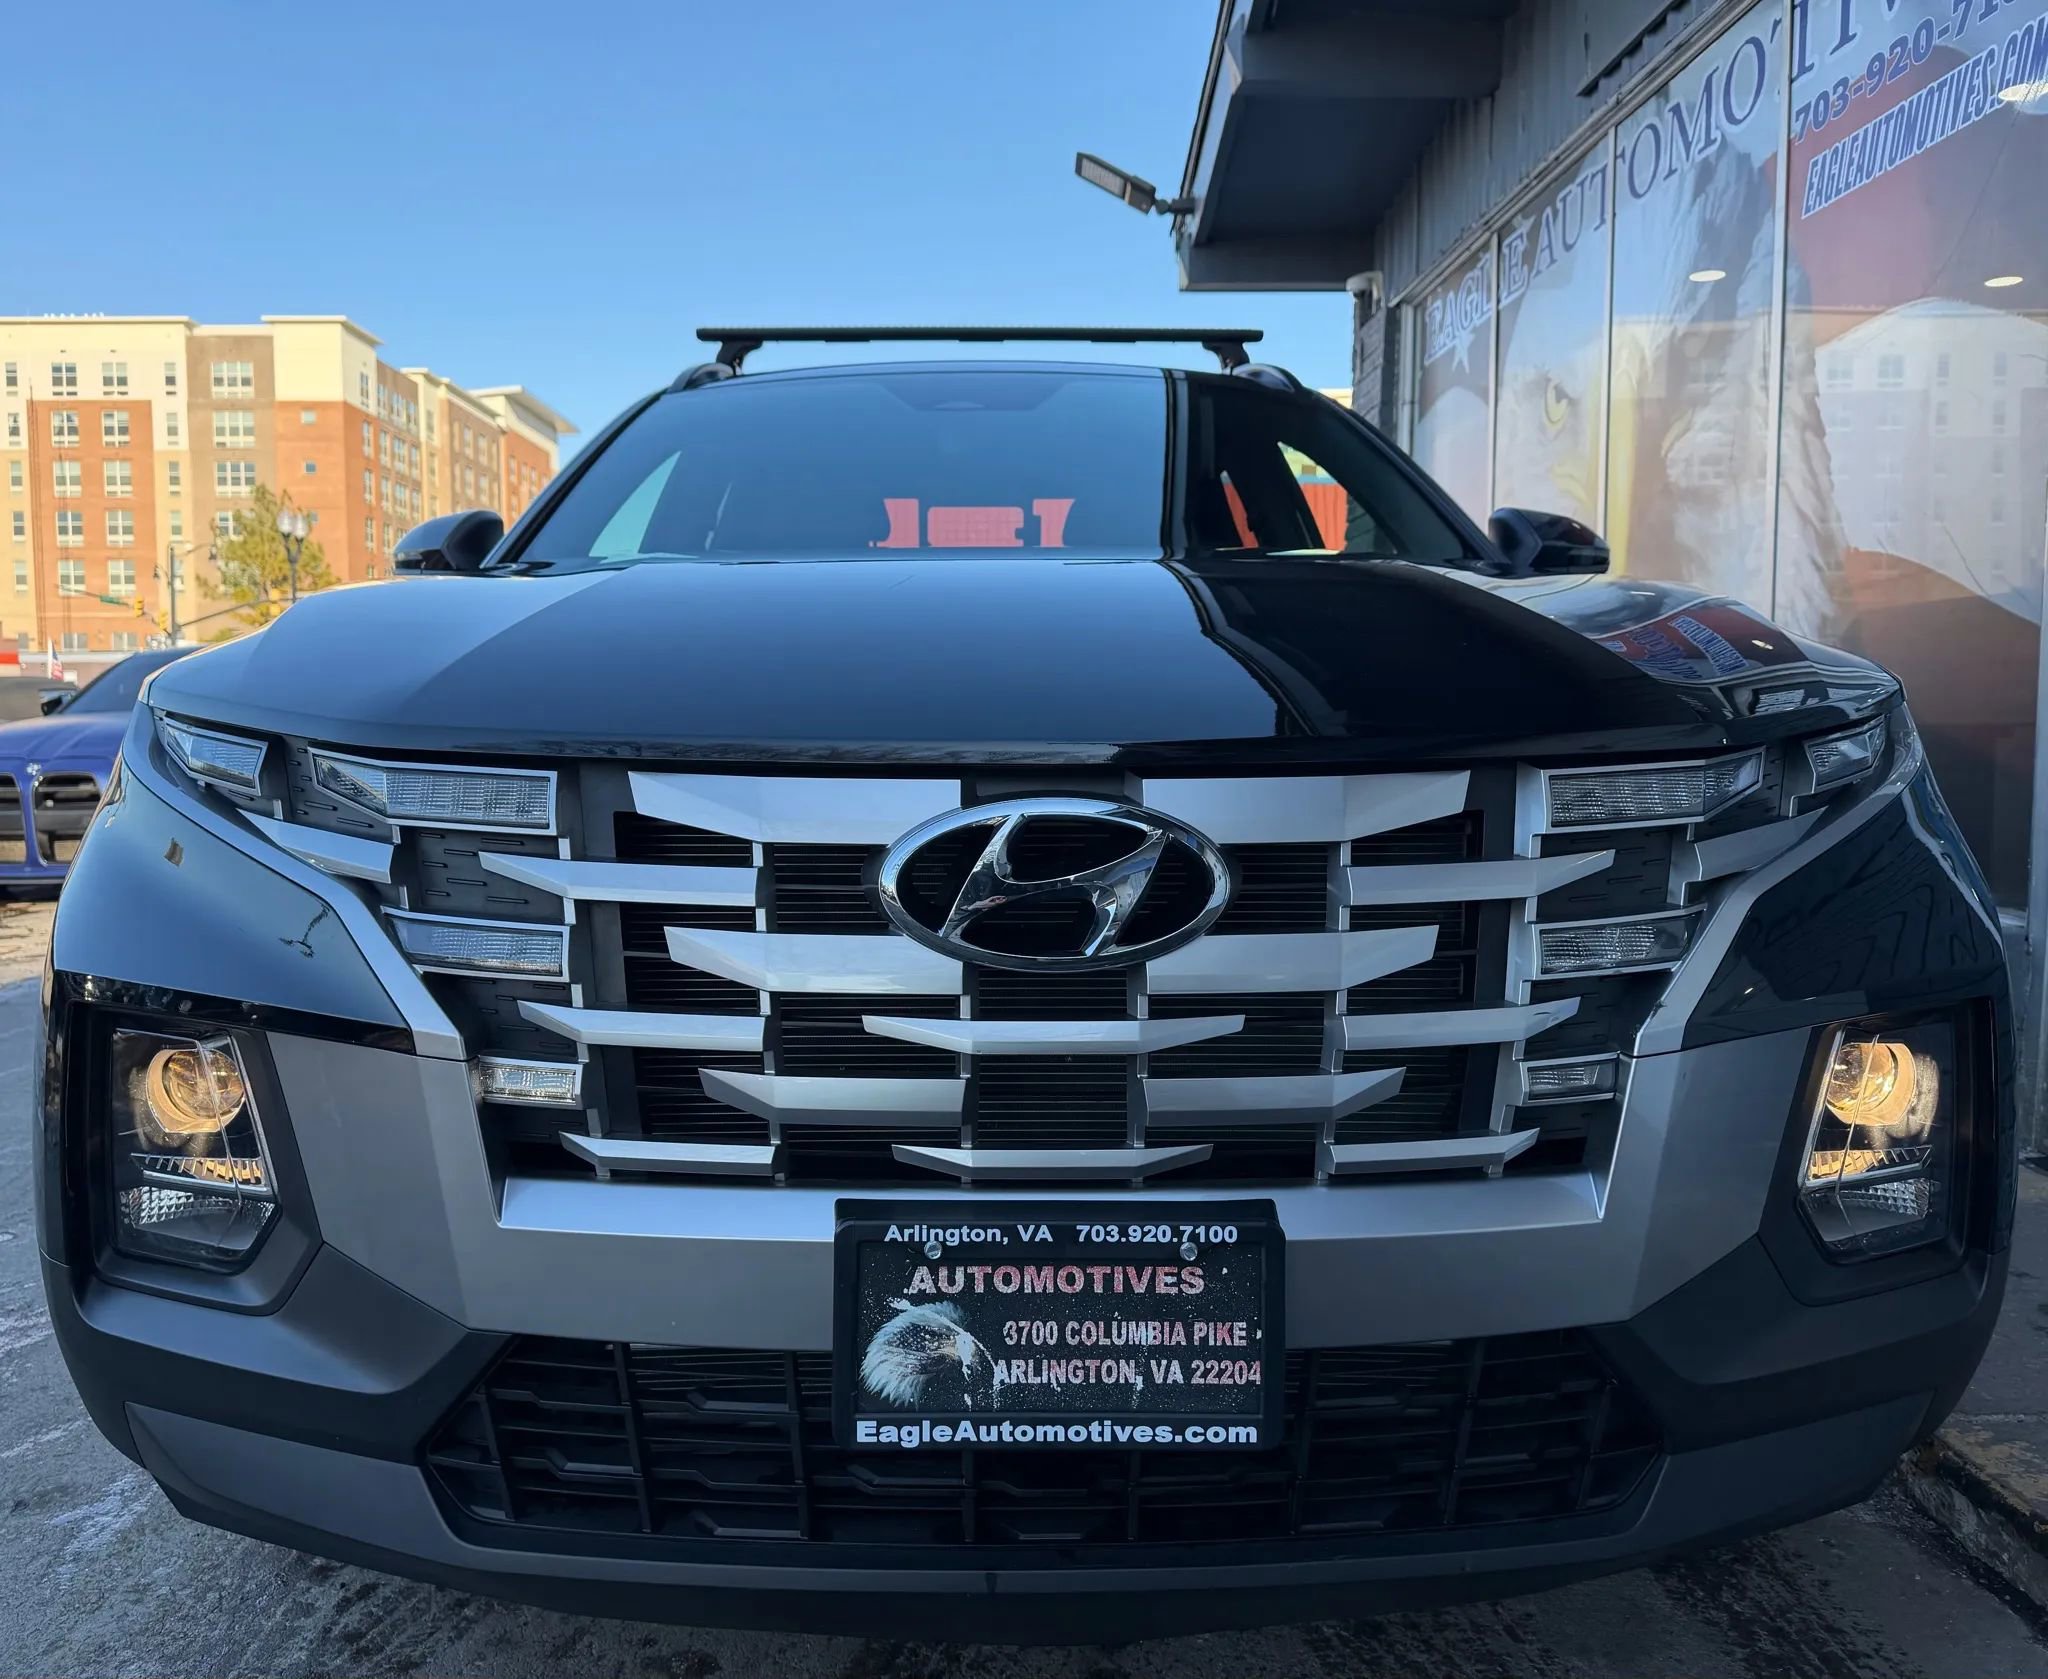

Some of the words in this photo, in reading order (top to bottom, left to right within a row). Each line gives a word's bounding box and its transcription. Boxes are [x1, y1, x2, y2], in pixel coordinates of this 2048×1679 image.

[1802, 12, 2048, 218] EAGLEAUTOMOTIVES.COM
[1424, 228, 1529, 366] EAGLE
[1532, 0, 1897, 278] AUTOMOTI
[884, 1225, 1009, 1246] Arlington,
[1017, 1225, 1053, 1242] VA
[1076, 1225, 1238, 1243] 703.920.7100
[908, 1265, 1205, 1294] AUTOMOTIVES
[1003, 1320, 1058, 1346] 3700
[1065, 1321, 1187, 1346] COLUMBIA
[1194, 1321, 1247, 1347] PIKE
[994, 1359, 1143, 1387] ARLINGTON,
[1150, 1359, 1184, 1384] VA
[1191, 1360, 1262, 1385] 22204
[856, 1420, 1258, 1448] EagleAutomotives.com
